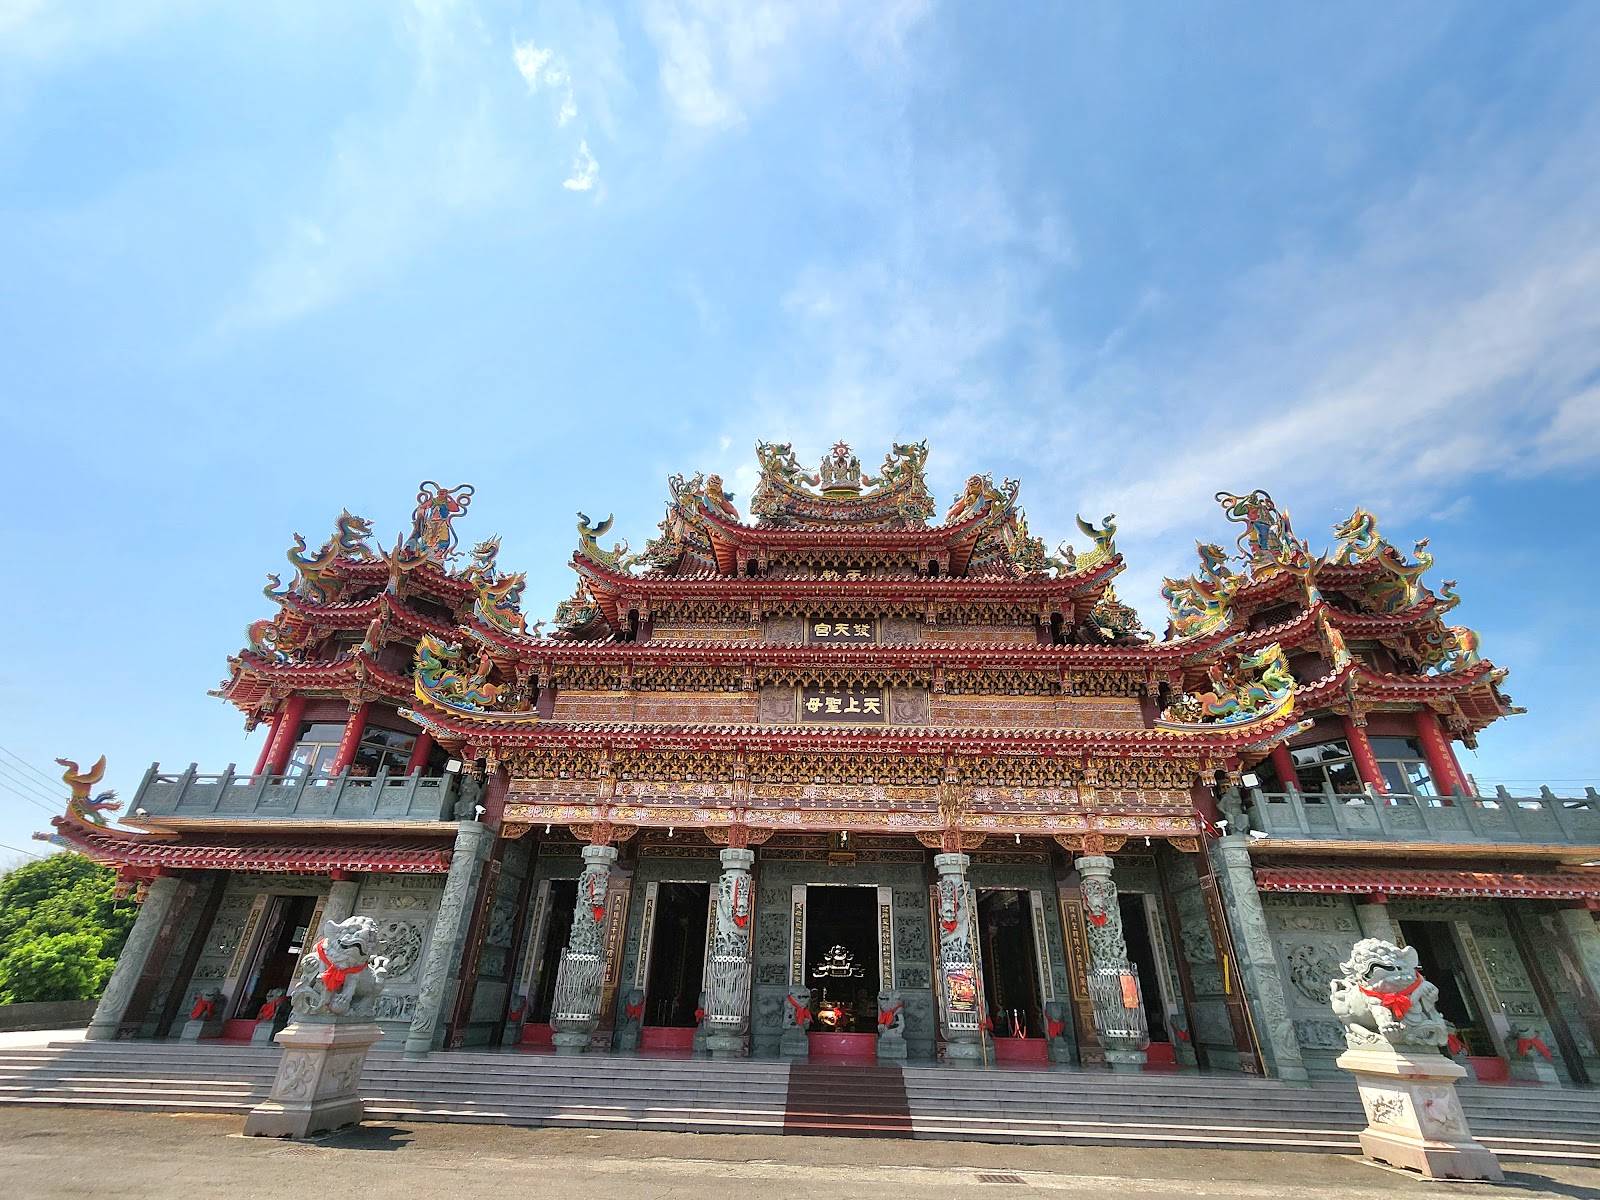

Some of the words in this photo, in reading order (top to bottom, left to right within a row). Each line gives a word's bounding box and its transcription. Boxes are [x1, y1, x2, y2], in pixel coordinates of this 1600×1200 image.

[814, 622, 871, 638] 發天宮
[805, 696, 881, 715] 天上聖母
